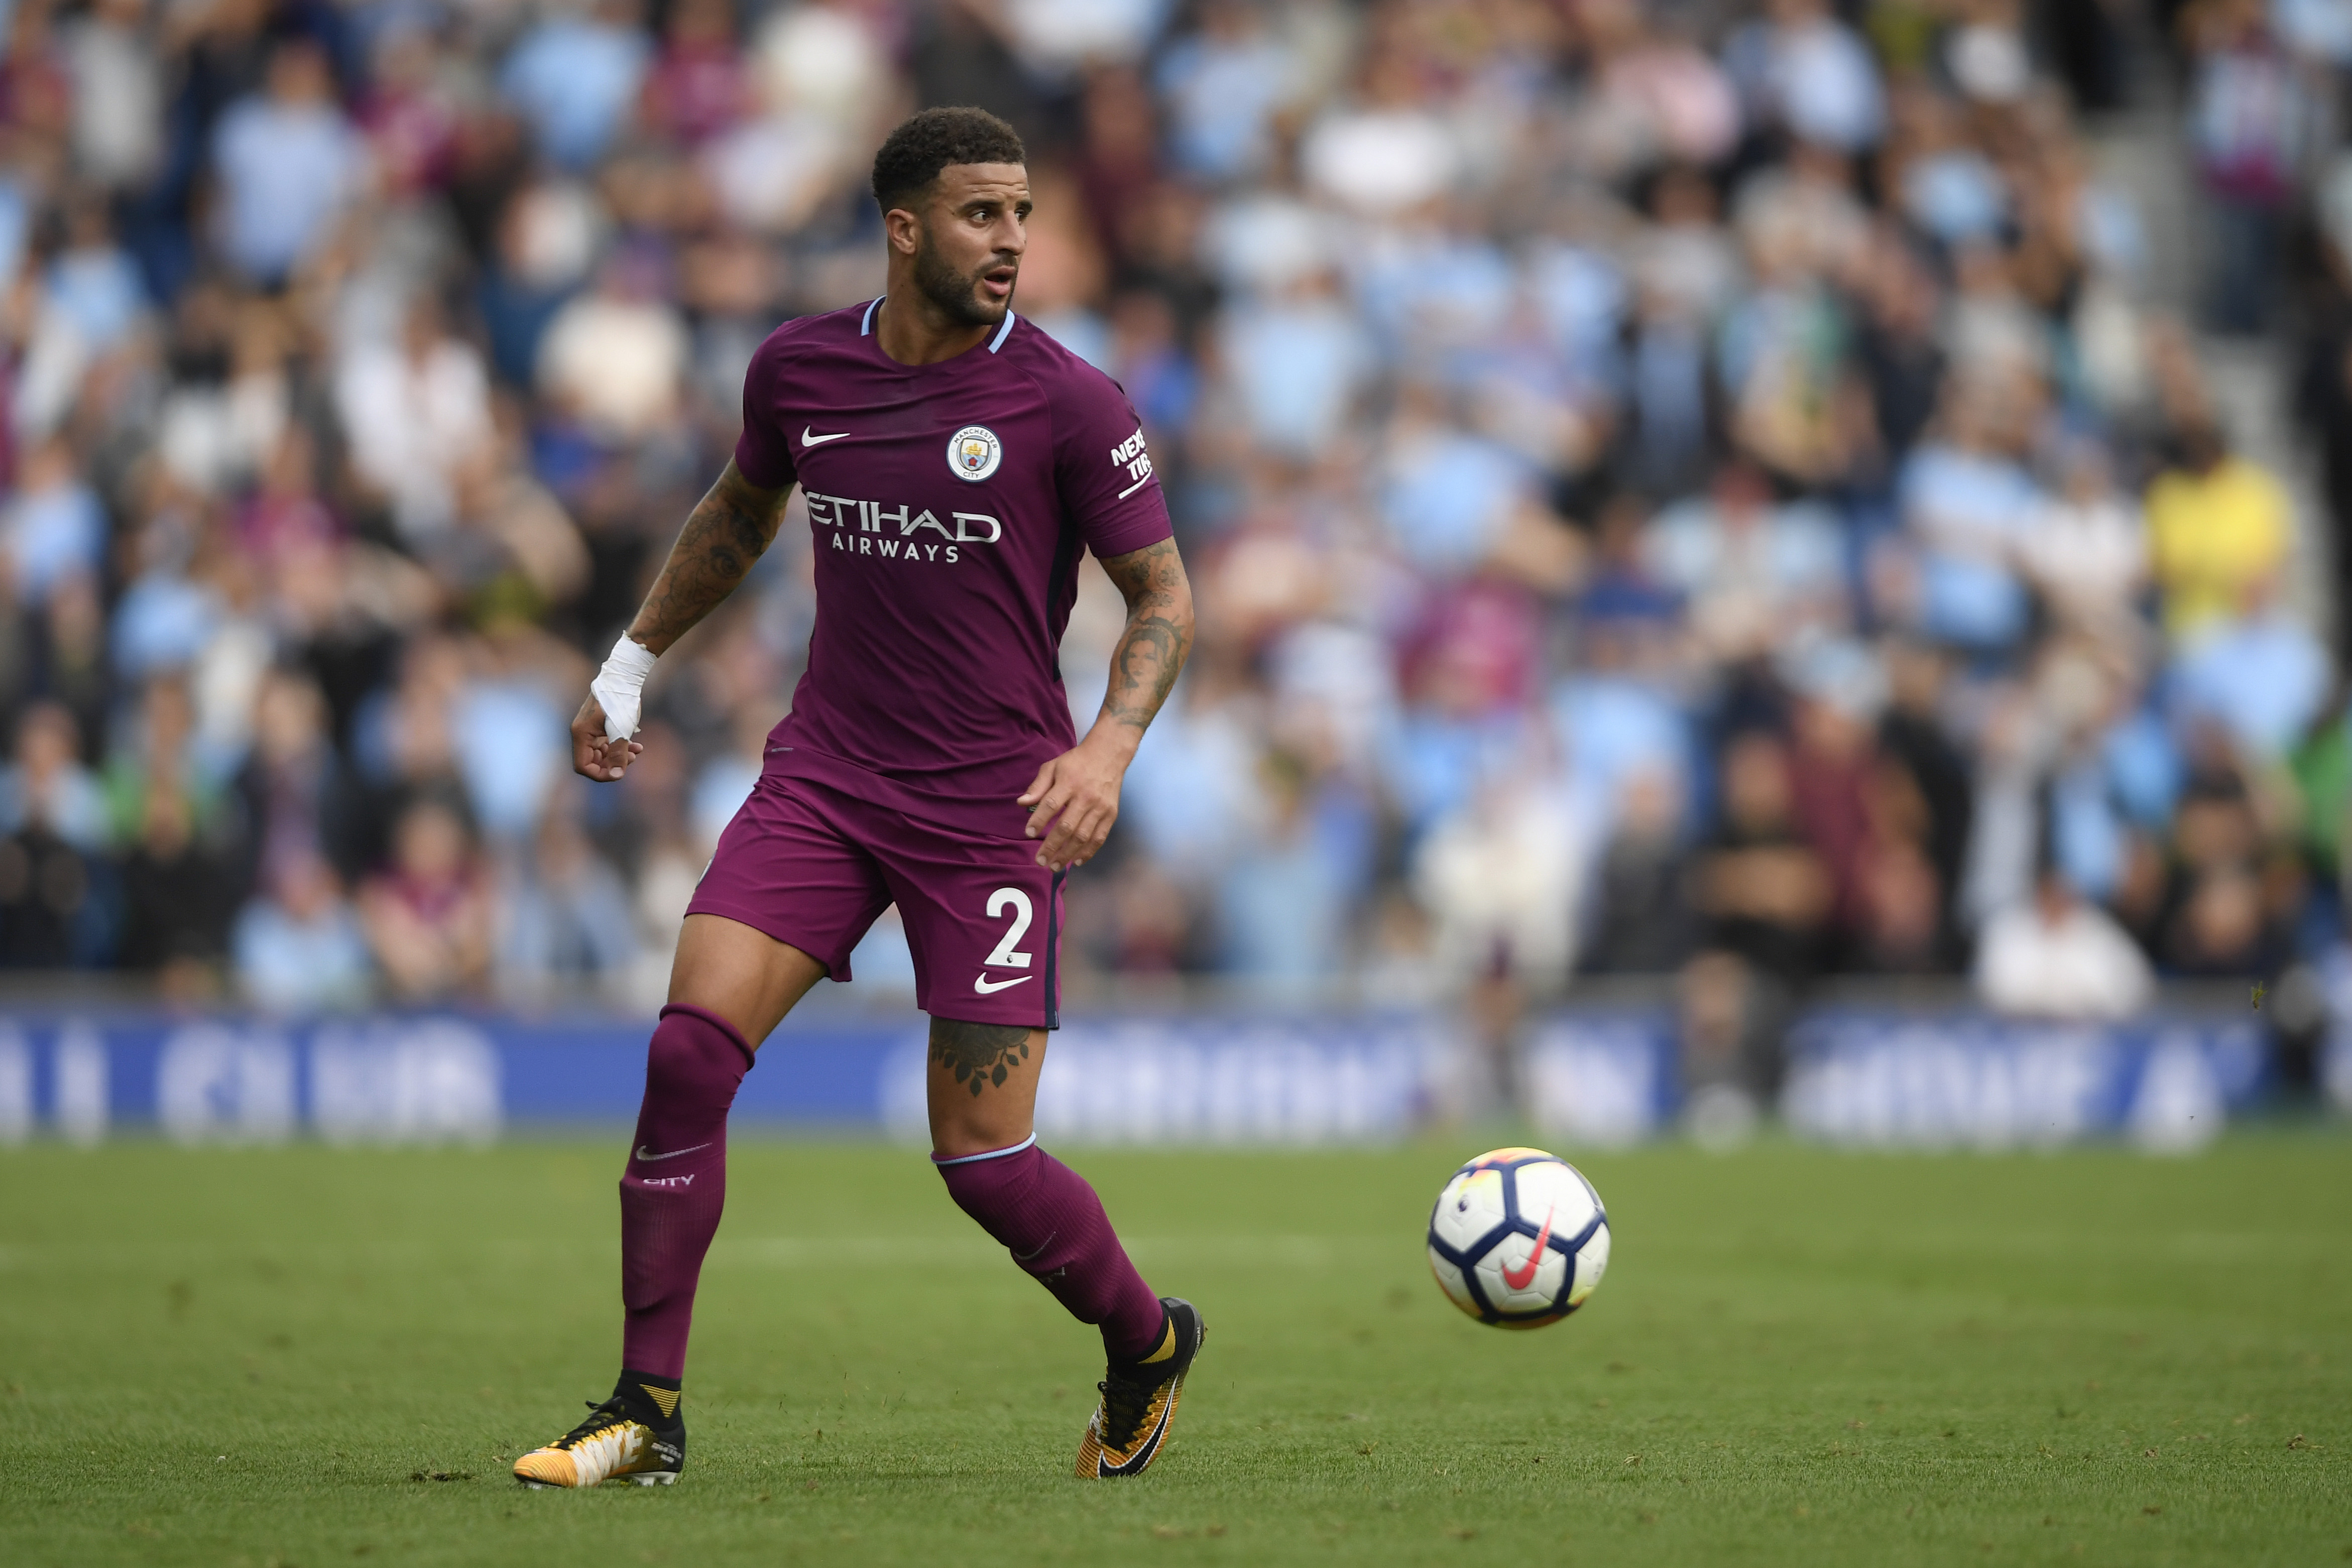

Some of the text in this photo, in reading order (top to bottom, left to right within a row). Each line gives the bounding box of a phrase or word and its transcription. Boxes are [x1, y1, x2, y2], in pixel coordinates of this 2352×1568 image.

[954, 428, 998, 448] MANCHESTER
[806, 491, 1001, 543] ETIHAD
[832, 532, 959, 563] AIRWAYS
[984, 887, 1033, 968] 2
[643, 1173, 695, 1186] CITY
